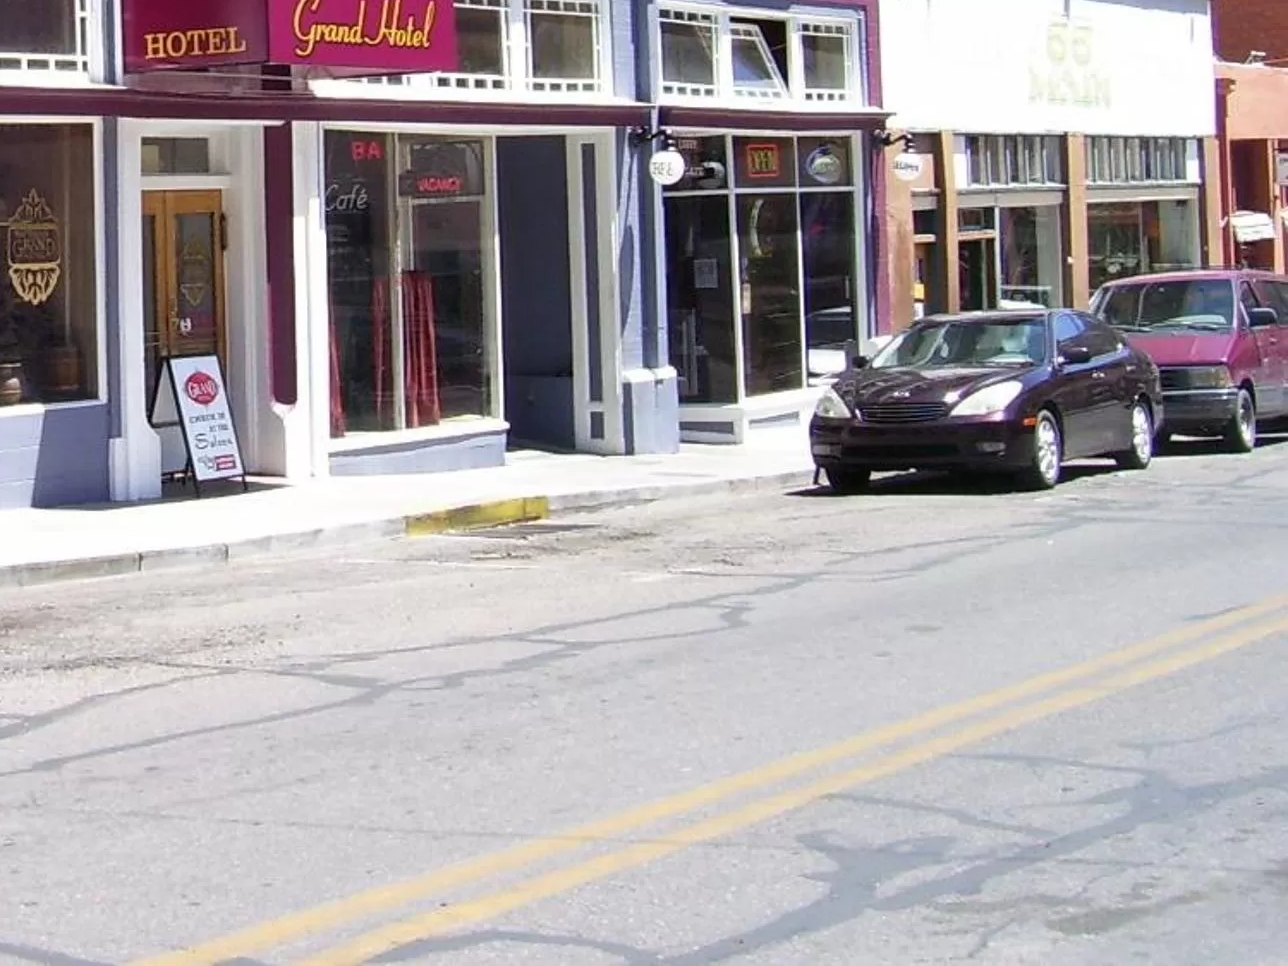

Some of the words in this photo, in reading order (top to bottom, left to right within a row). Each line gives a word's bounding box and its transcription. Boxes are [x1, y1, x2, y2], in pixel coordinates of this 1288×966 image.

[144, 27, 246, 59] HOTEL
[351, 141, 382, 160] BA
[325, 184, 368, 211] Café
